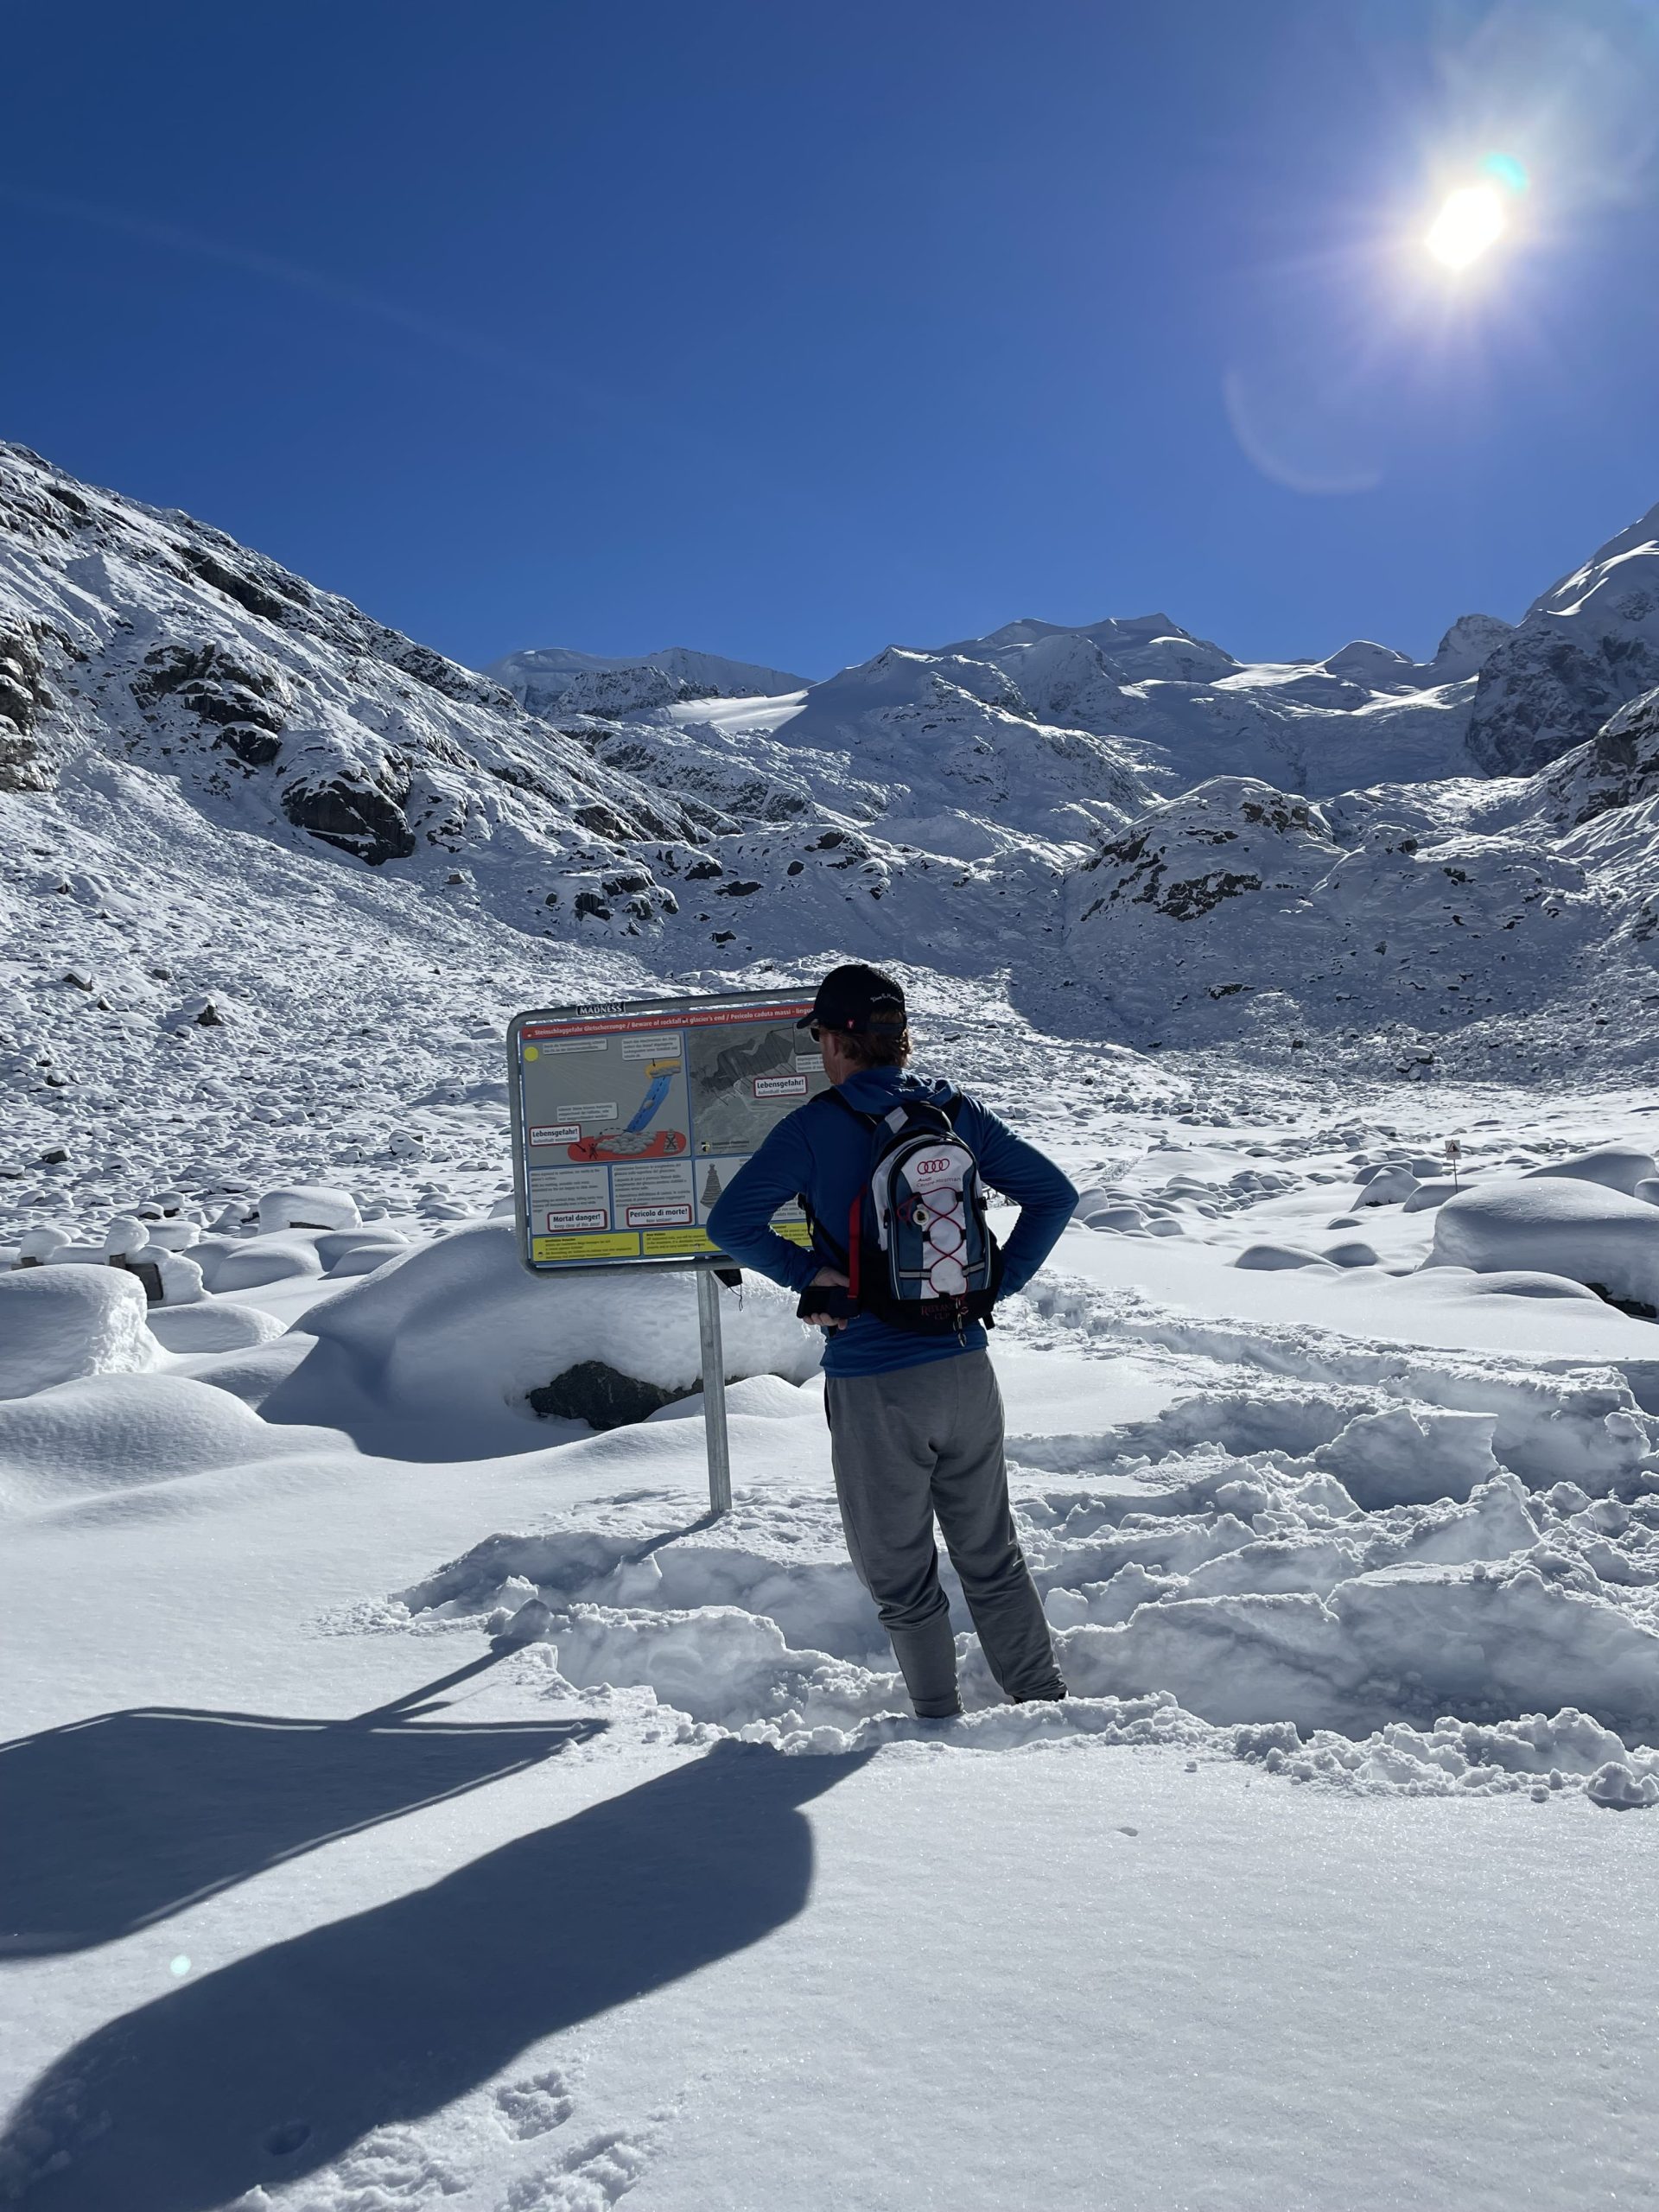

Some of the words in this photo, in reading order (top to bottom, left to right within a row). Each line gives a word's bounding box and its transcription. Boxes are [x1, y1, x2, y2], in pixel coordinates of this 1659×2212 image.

[580, 1003, 623, 1014] MADNESS
[535, 1026, 582, 1036] Steinschlaggefahr
[584, 1023, 626, 1032] Gletscherzunge
[690, 1015, 714, 1025] glacier's
[757, 1079, 804, 1089] Lebensgefahr!
[532, 1128, 578, 1138] Lebensgefahr!
[575, 1213, 601, 1223] danger!
